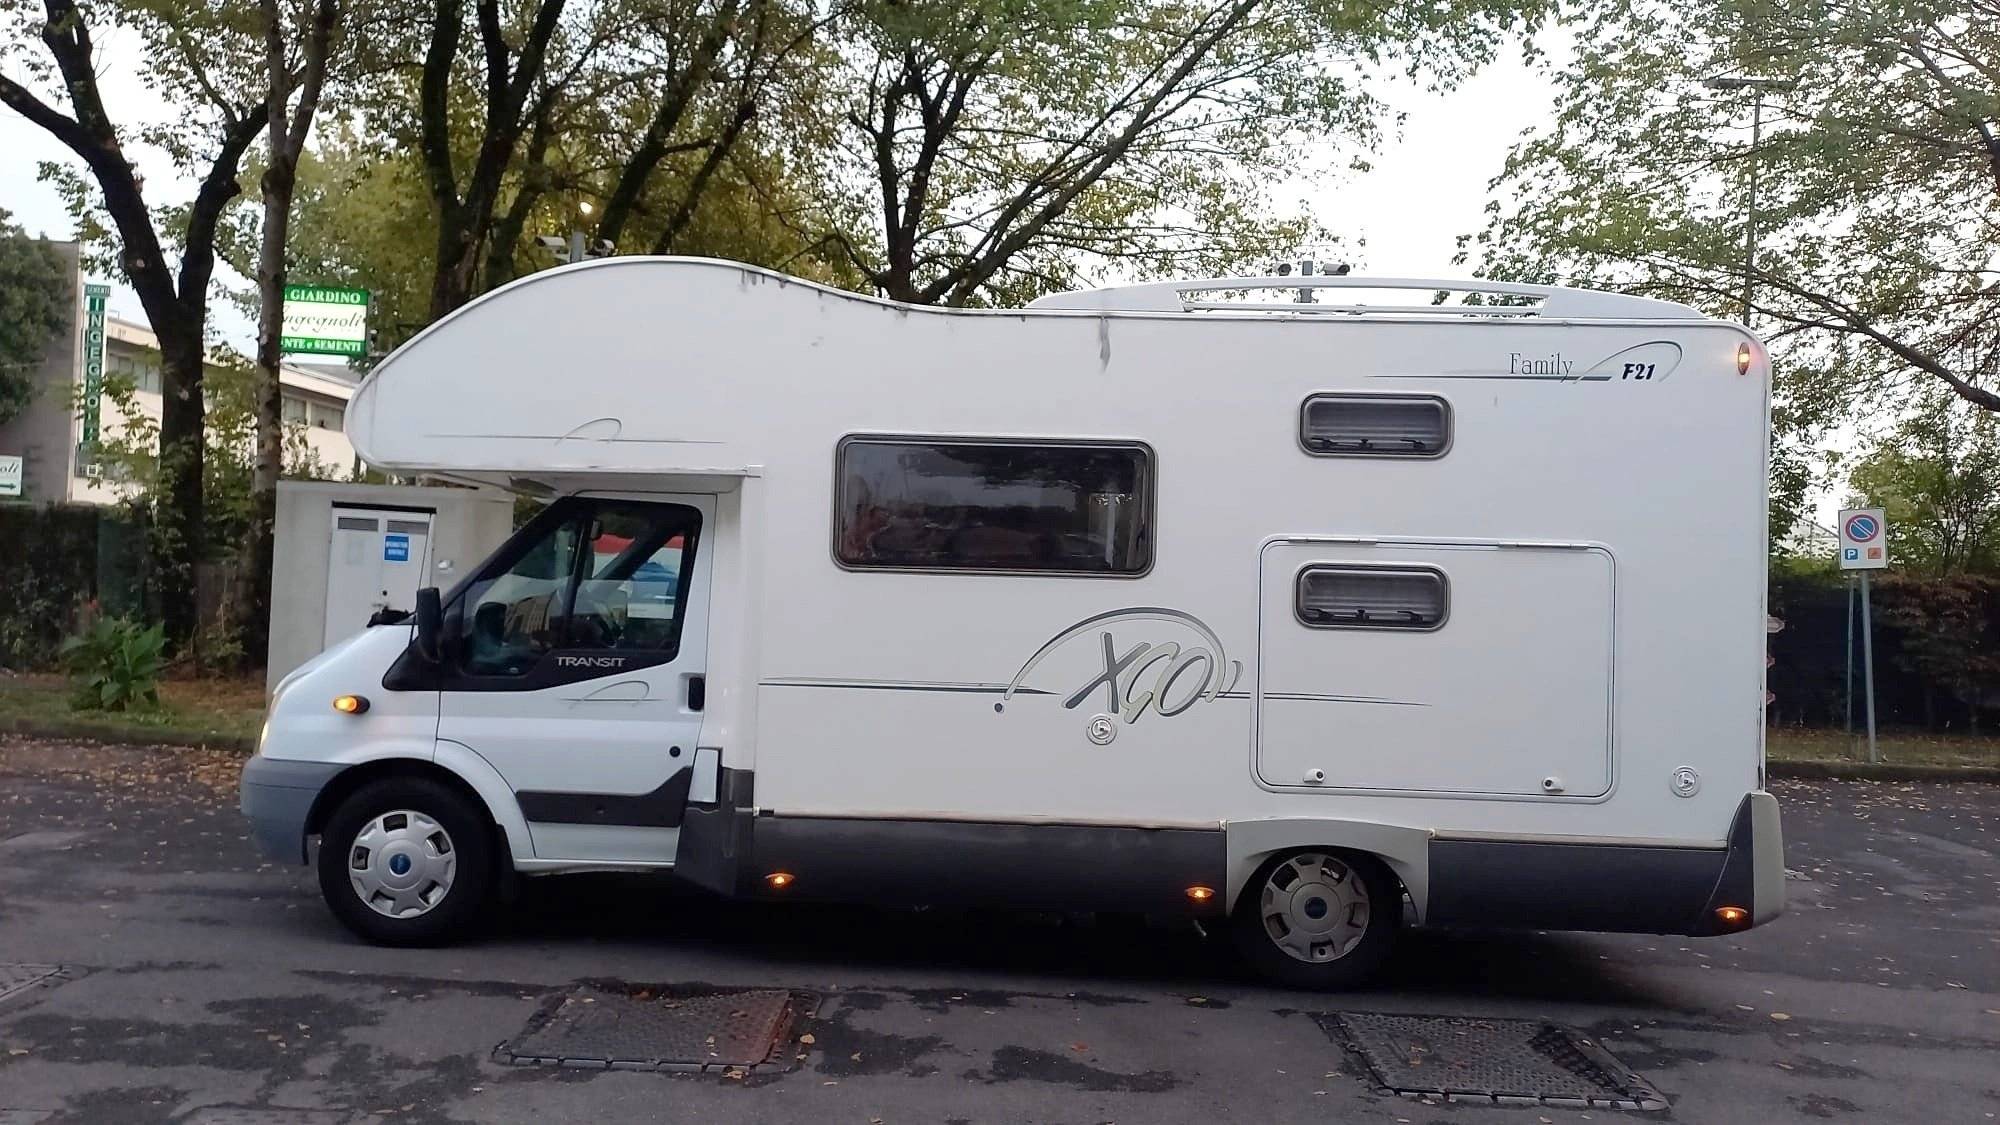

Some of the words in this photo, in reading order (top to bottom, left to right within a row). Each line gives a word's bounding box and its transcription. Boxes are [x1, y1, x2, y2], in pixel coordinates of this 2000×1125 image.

[290, 289, 361, 304] GIARDINO
[314, 338, 361, 352] SEMENTI
[1509, 352, 1573, 383] Family
[1622, 363, 1656, 380] F21
[557, 656, 625, 668] TRANSIT
